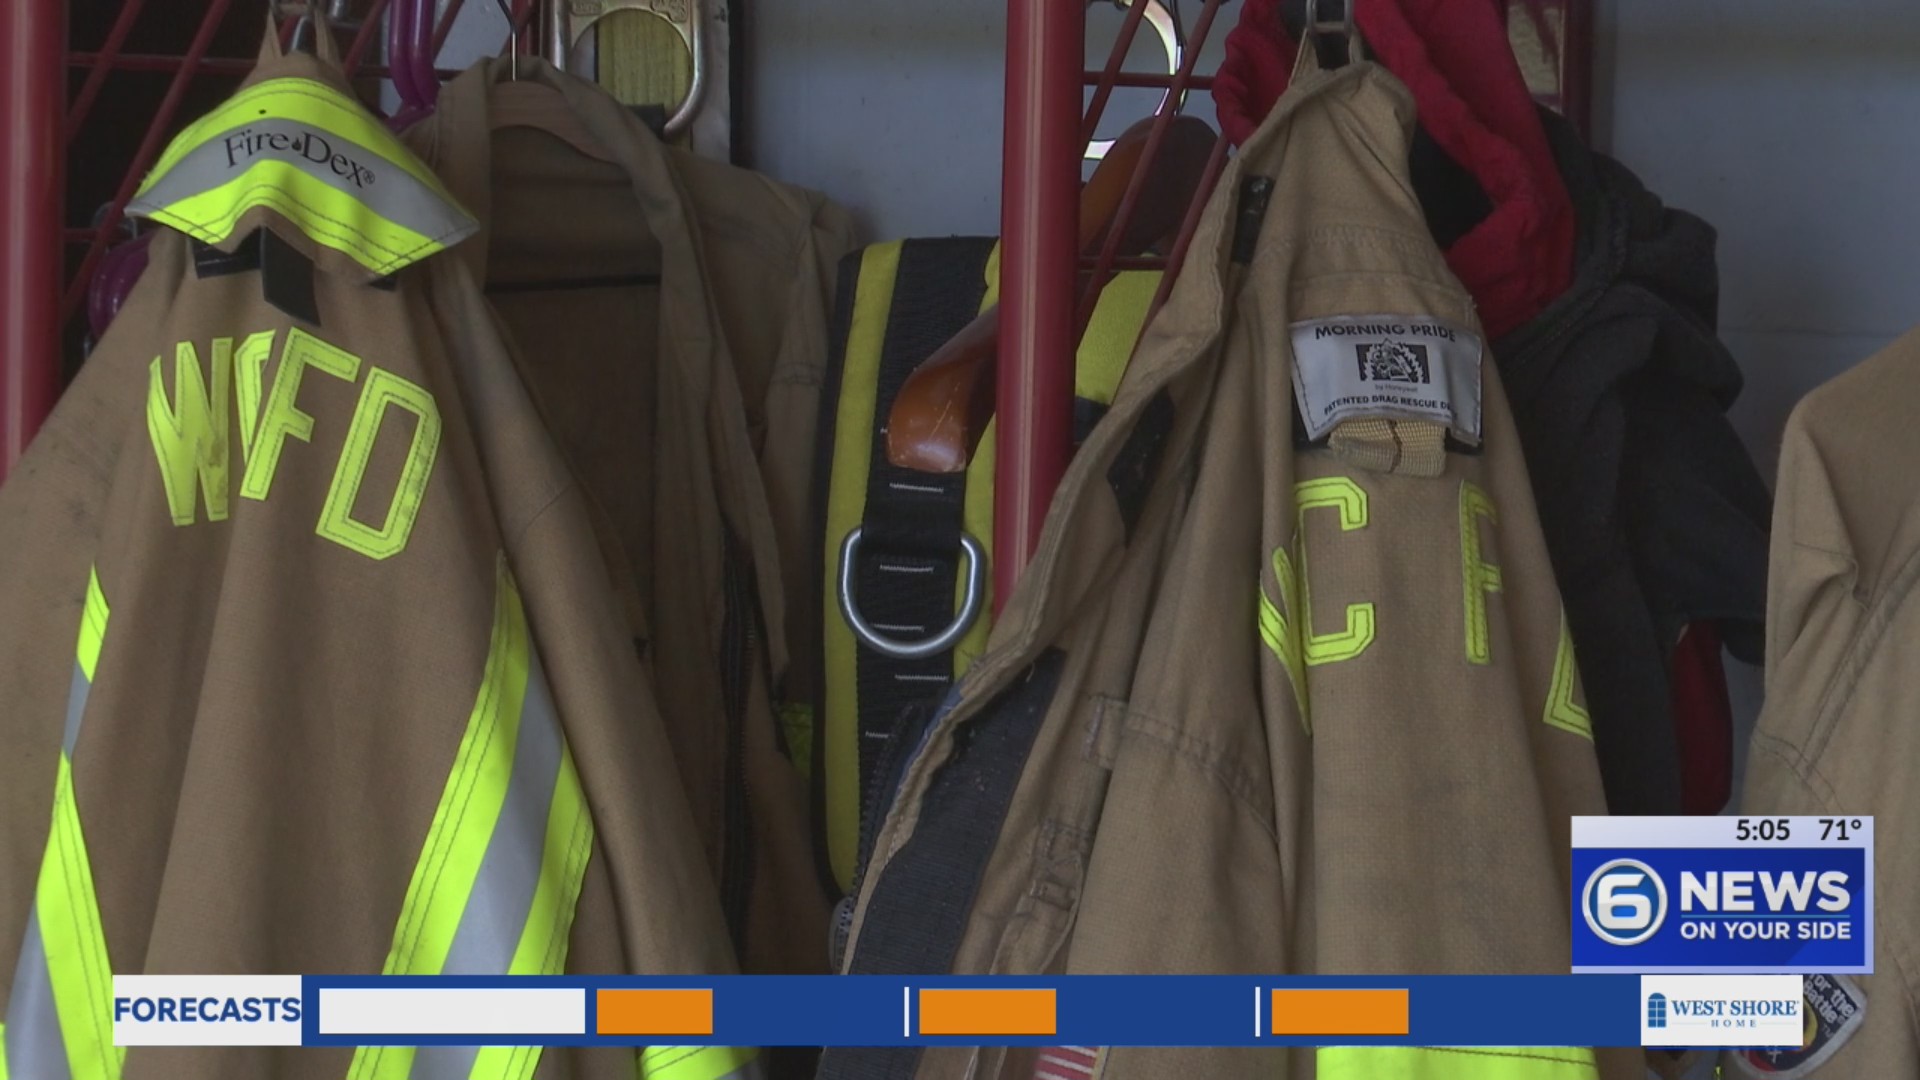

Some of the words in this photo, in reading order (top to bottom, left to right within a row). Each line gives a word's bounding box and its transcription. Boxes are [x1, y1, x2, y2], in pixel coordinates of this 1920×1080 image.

[1315, 324, 1405, 340] MORNING
[1411, 324, 1456, 343] PRIDE
[1324, 395, 1369, 415] PATENTED
[1372, 395, 1398, 405] DRAG
[1400, 397, 1438, 408] RESCUE
[1830, 989, 1856, 1018] the
